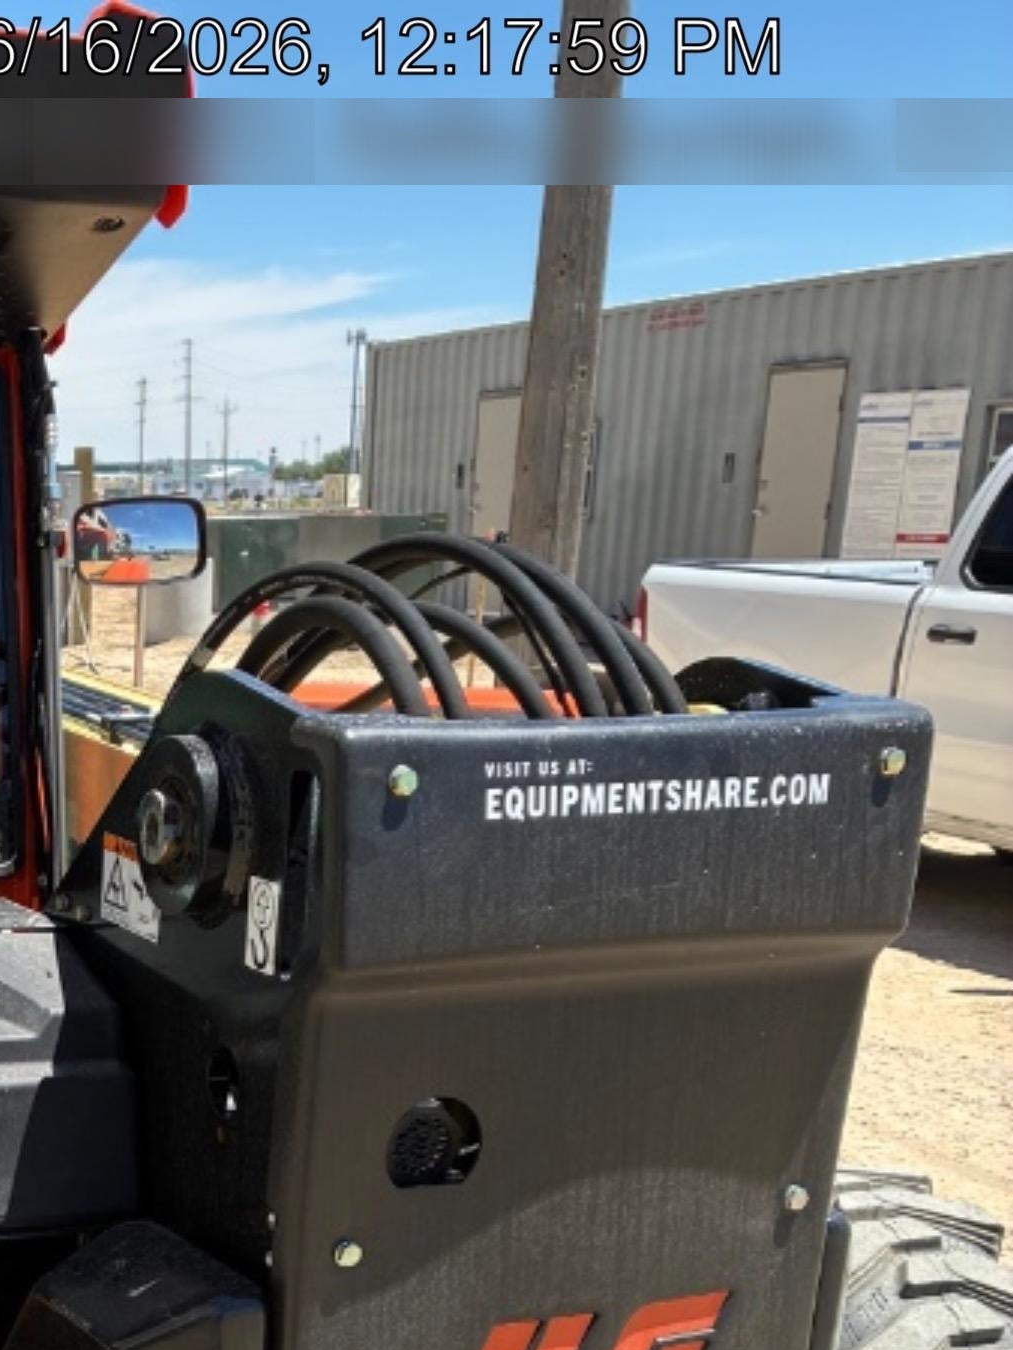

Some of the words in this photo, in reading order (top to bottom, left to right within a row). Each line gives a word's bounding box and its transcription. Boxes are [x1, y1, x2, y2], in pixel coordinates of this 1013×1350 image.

[485, 761, 531, 778] VISIT
[539, 761, 560, 776] US
[485, 773, 830, 821] EQUIPMENTSHARE.COM
